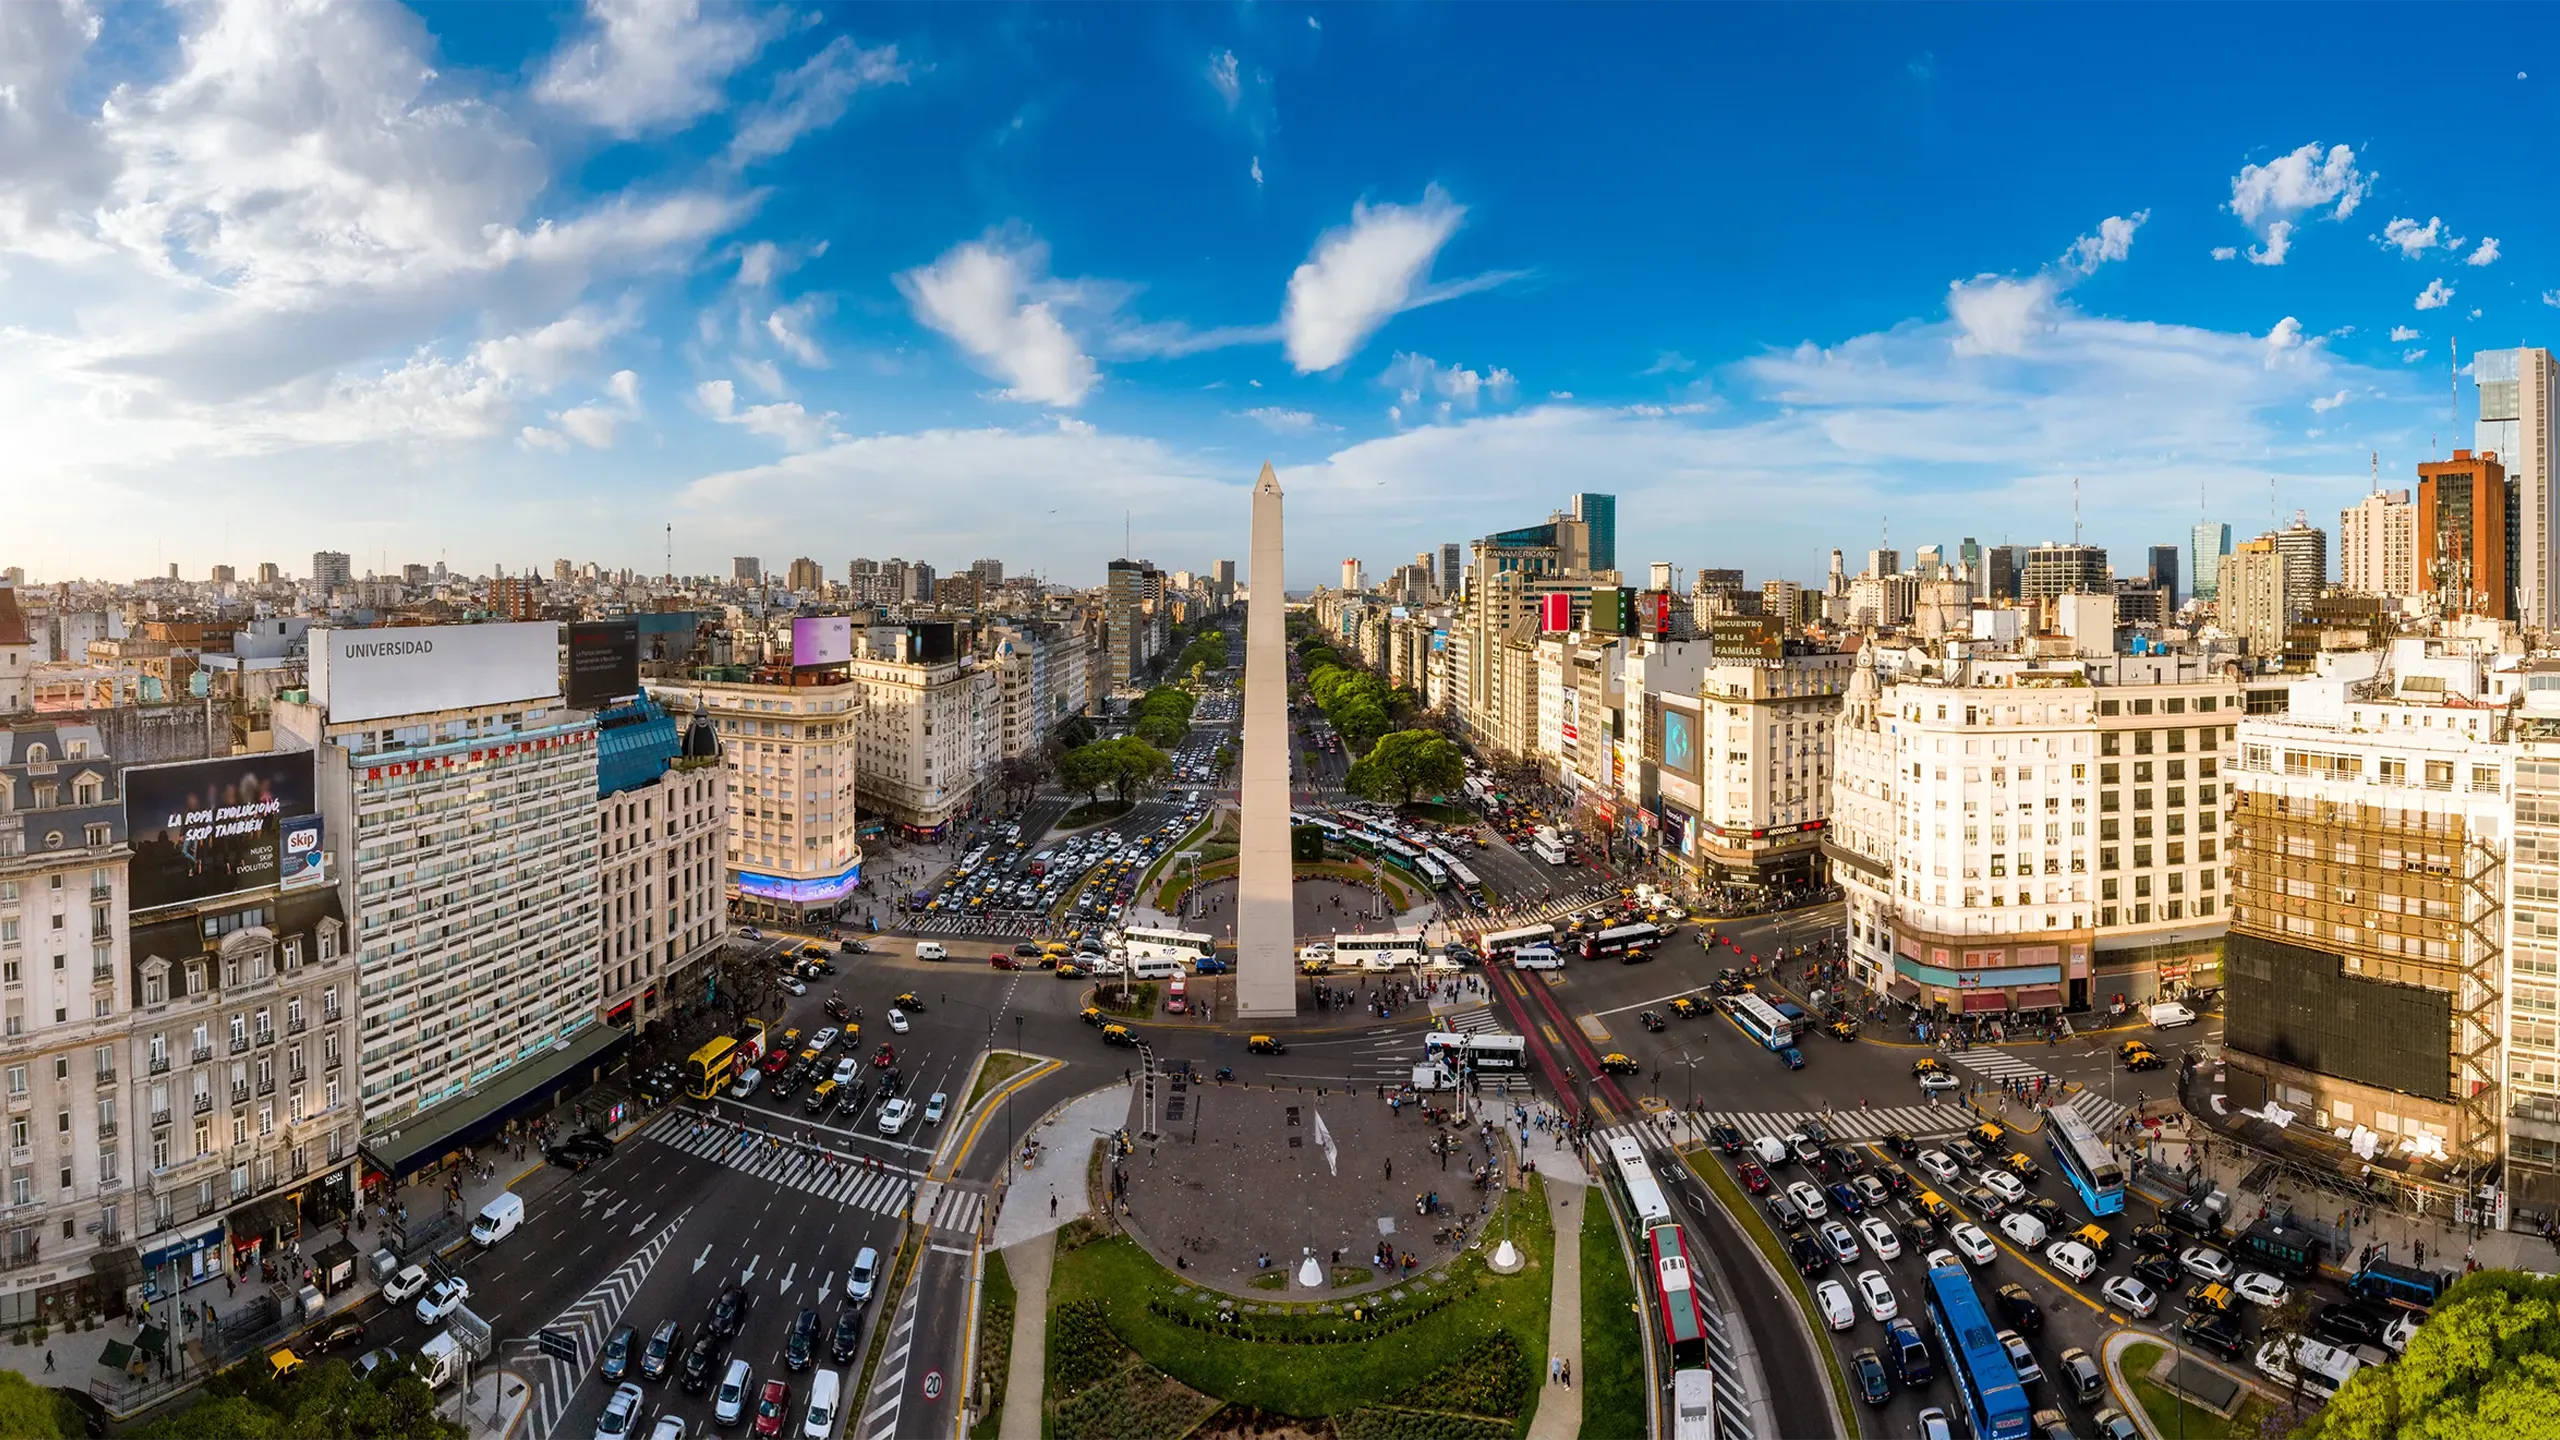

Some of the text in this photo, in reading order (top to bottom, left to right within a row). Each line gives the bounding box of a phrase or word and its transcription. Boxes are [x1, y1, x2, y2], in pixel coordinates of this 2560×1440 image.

[1486, 550, 1555, 558] PANAMERICANO
[1714, 633, 1745, 641] DE LAS
[345, 640, 433, 659] UNIVERSIDAD
[1714, 646, 1762, 655] FAMILIAS
[368, 729, 596, 780] HOTEL REPUBLICA
[167, 813, 182, 828] LA
[185, 809, 213, 825] ROPA
[185, 817, 264, 841] SKIP TAMBIÉN
[1768, 826, 1797, 836] ABOGADOS
[290, 832, 315, 848] skip
[250, 845, 274, 855] NUEVO
[259, 854, 274, 863] SKIP
[236, 861, 274, 874] EVOLUTION
[324, 1170, 344, 1183] CANAL
[925, 1375, 941, 1395] 20
